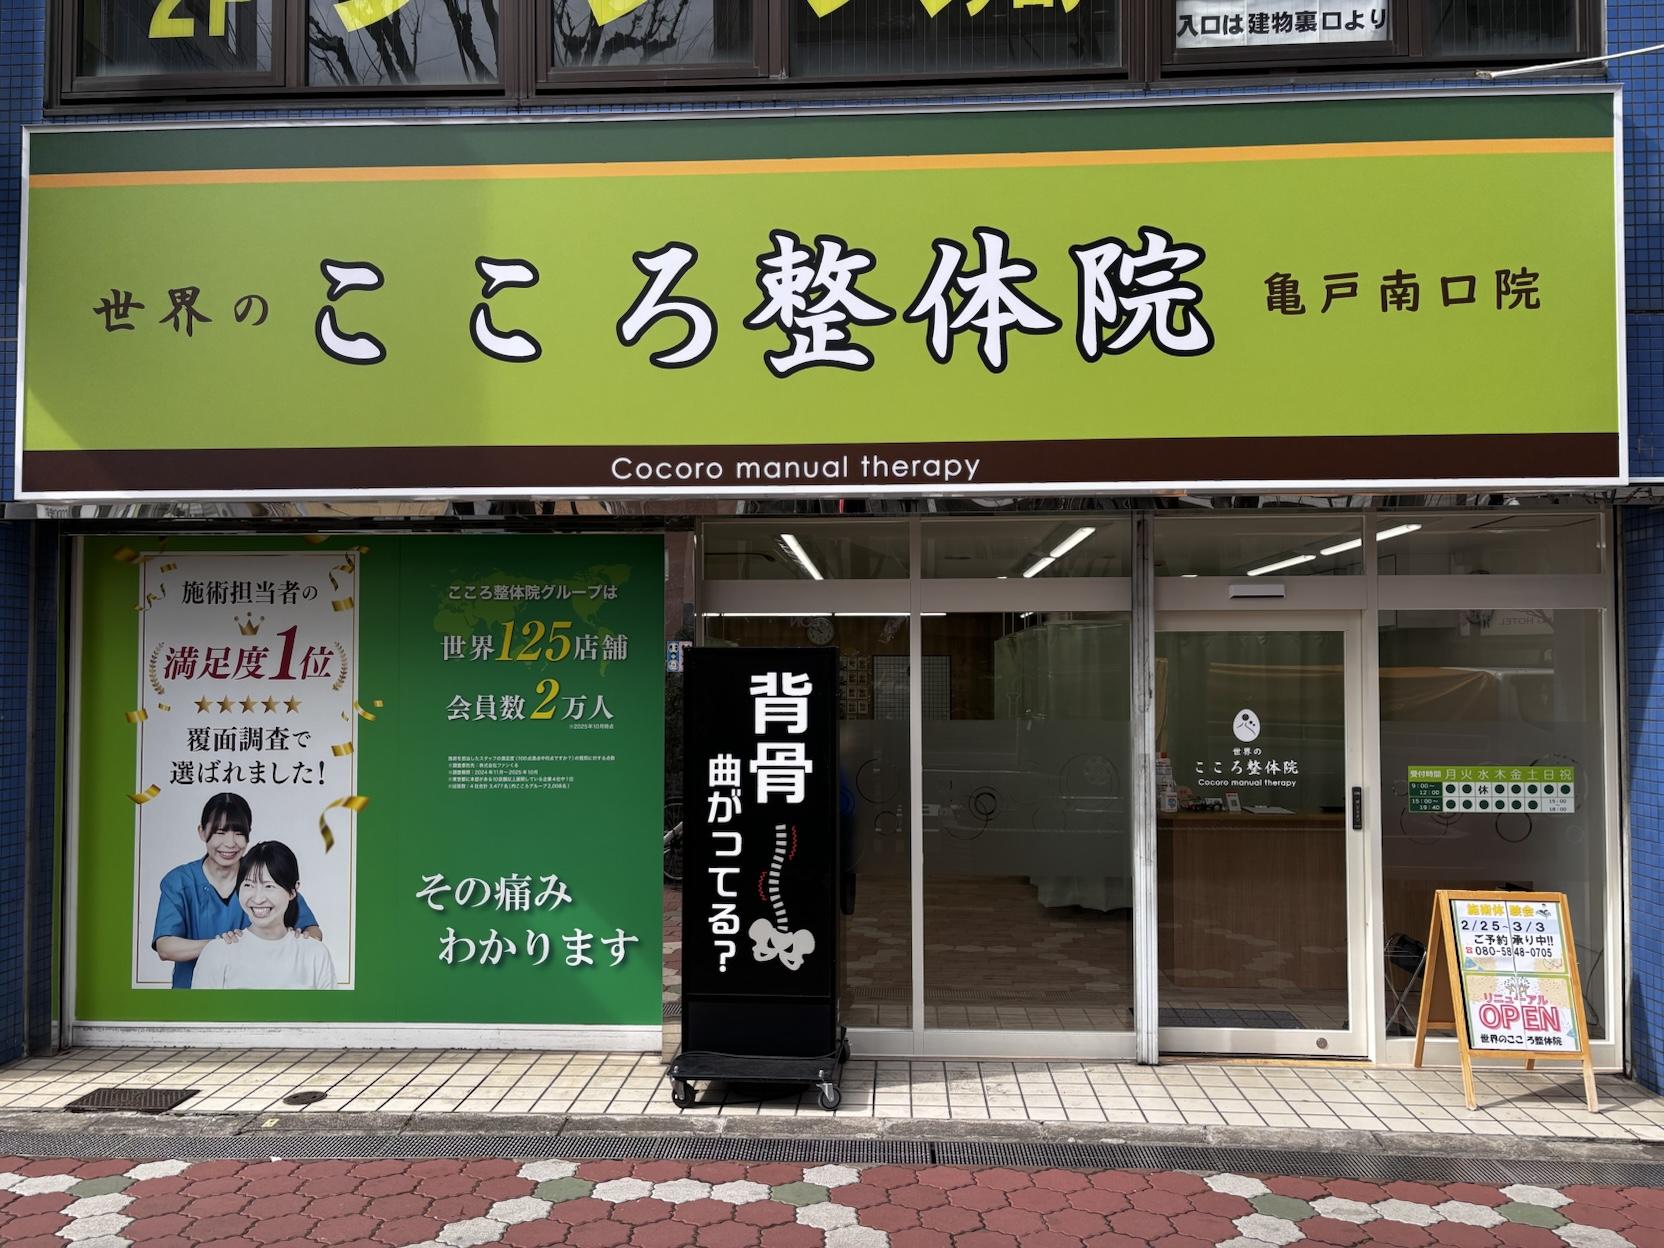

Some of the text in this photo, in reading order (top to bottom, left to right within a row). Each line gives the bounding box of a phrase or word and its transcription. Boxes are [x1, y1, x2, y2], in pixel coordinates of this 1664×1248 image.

[1176, 9, 1386, 38] 入口は建物裏口より
[93, 226, 1541, 378] 世界の こころ整体院 亀戸南口院
[611, 454, 980, 481] Cocoro manual therapy
[181, 581, 318, 605] 施術担当者の
[448, 584, 618, 600] こころ整体院グループは
[163, 625, 334, 681] 満足度1位
[440, 619, 628, 662] 世界125店舗
[446, 679, 614, 721] 会員数2万人
[186, 726, 311, 752] 覆面調査で
[750, 672, 813, 804] 背骨
[1233, 747, 1262, 756] 世界の
[1195, 759, 1299, 776] こころ整体院
[1410, 769, 1572, 780] 受付時間 月 火 水 木 金 土 日 祝
[1198, 779, 1229, 787] Cocoro
[1264, 779, 1297, 788] therapy
[1478, 784, 1489, 795] 休
[416, 873, 572, 912] その痛み
[439, 927, 639, 967] わかります
[1478, 1003, 1562, 1033] OPEN
[1480, 1034, 1564, 1047] 世界のこころ整体院
